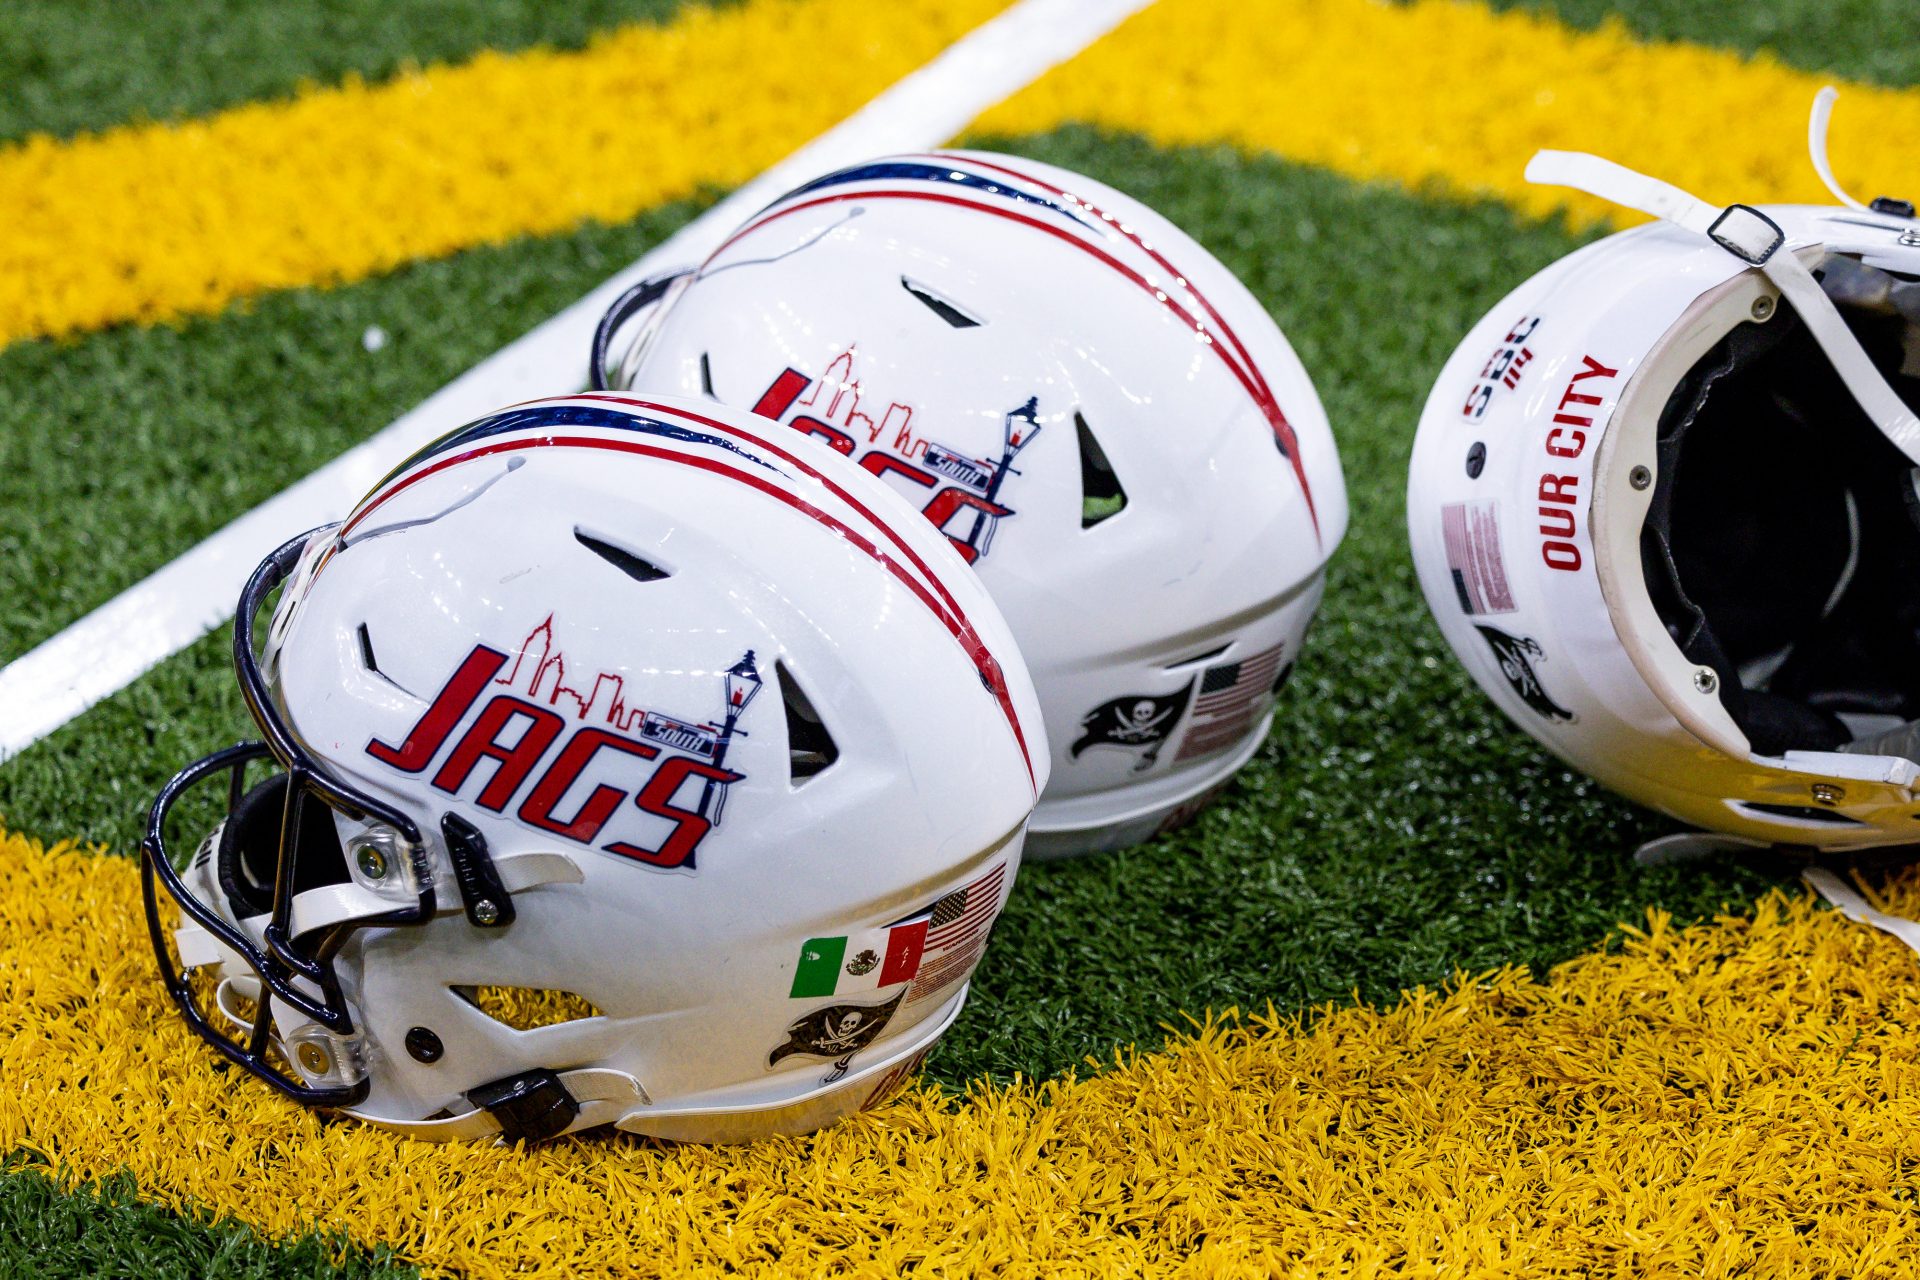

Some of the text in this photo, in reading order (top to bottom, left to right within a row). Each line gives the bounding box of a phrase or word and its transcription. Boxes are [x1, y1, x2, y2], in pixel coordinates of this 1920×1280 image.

[1462, 316, 1541, 418] SBC
[935, 456, 981, 485] SOUTH
[1538, 354, 1619, 572] OUR CITY
[365, 643, 747, 868] JAGS
[654, 724, 705, 752] SOUTH
